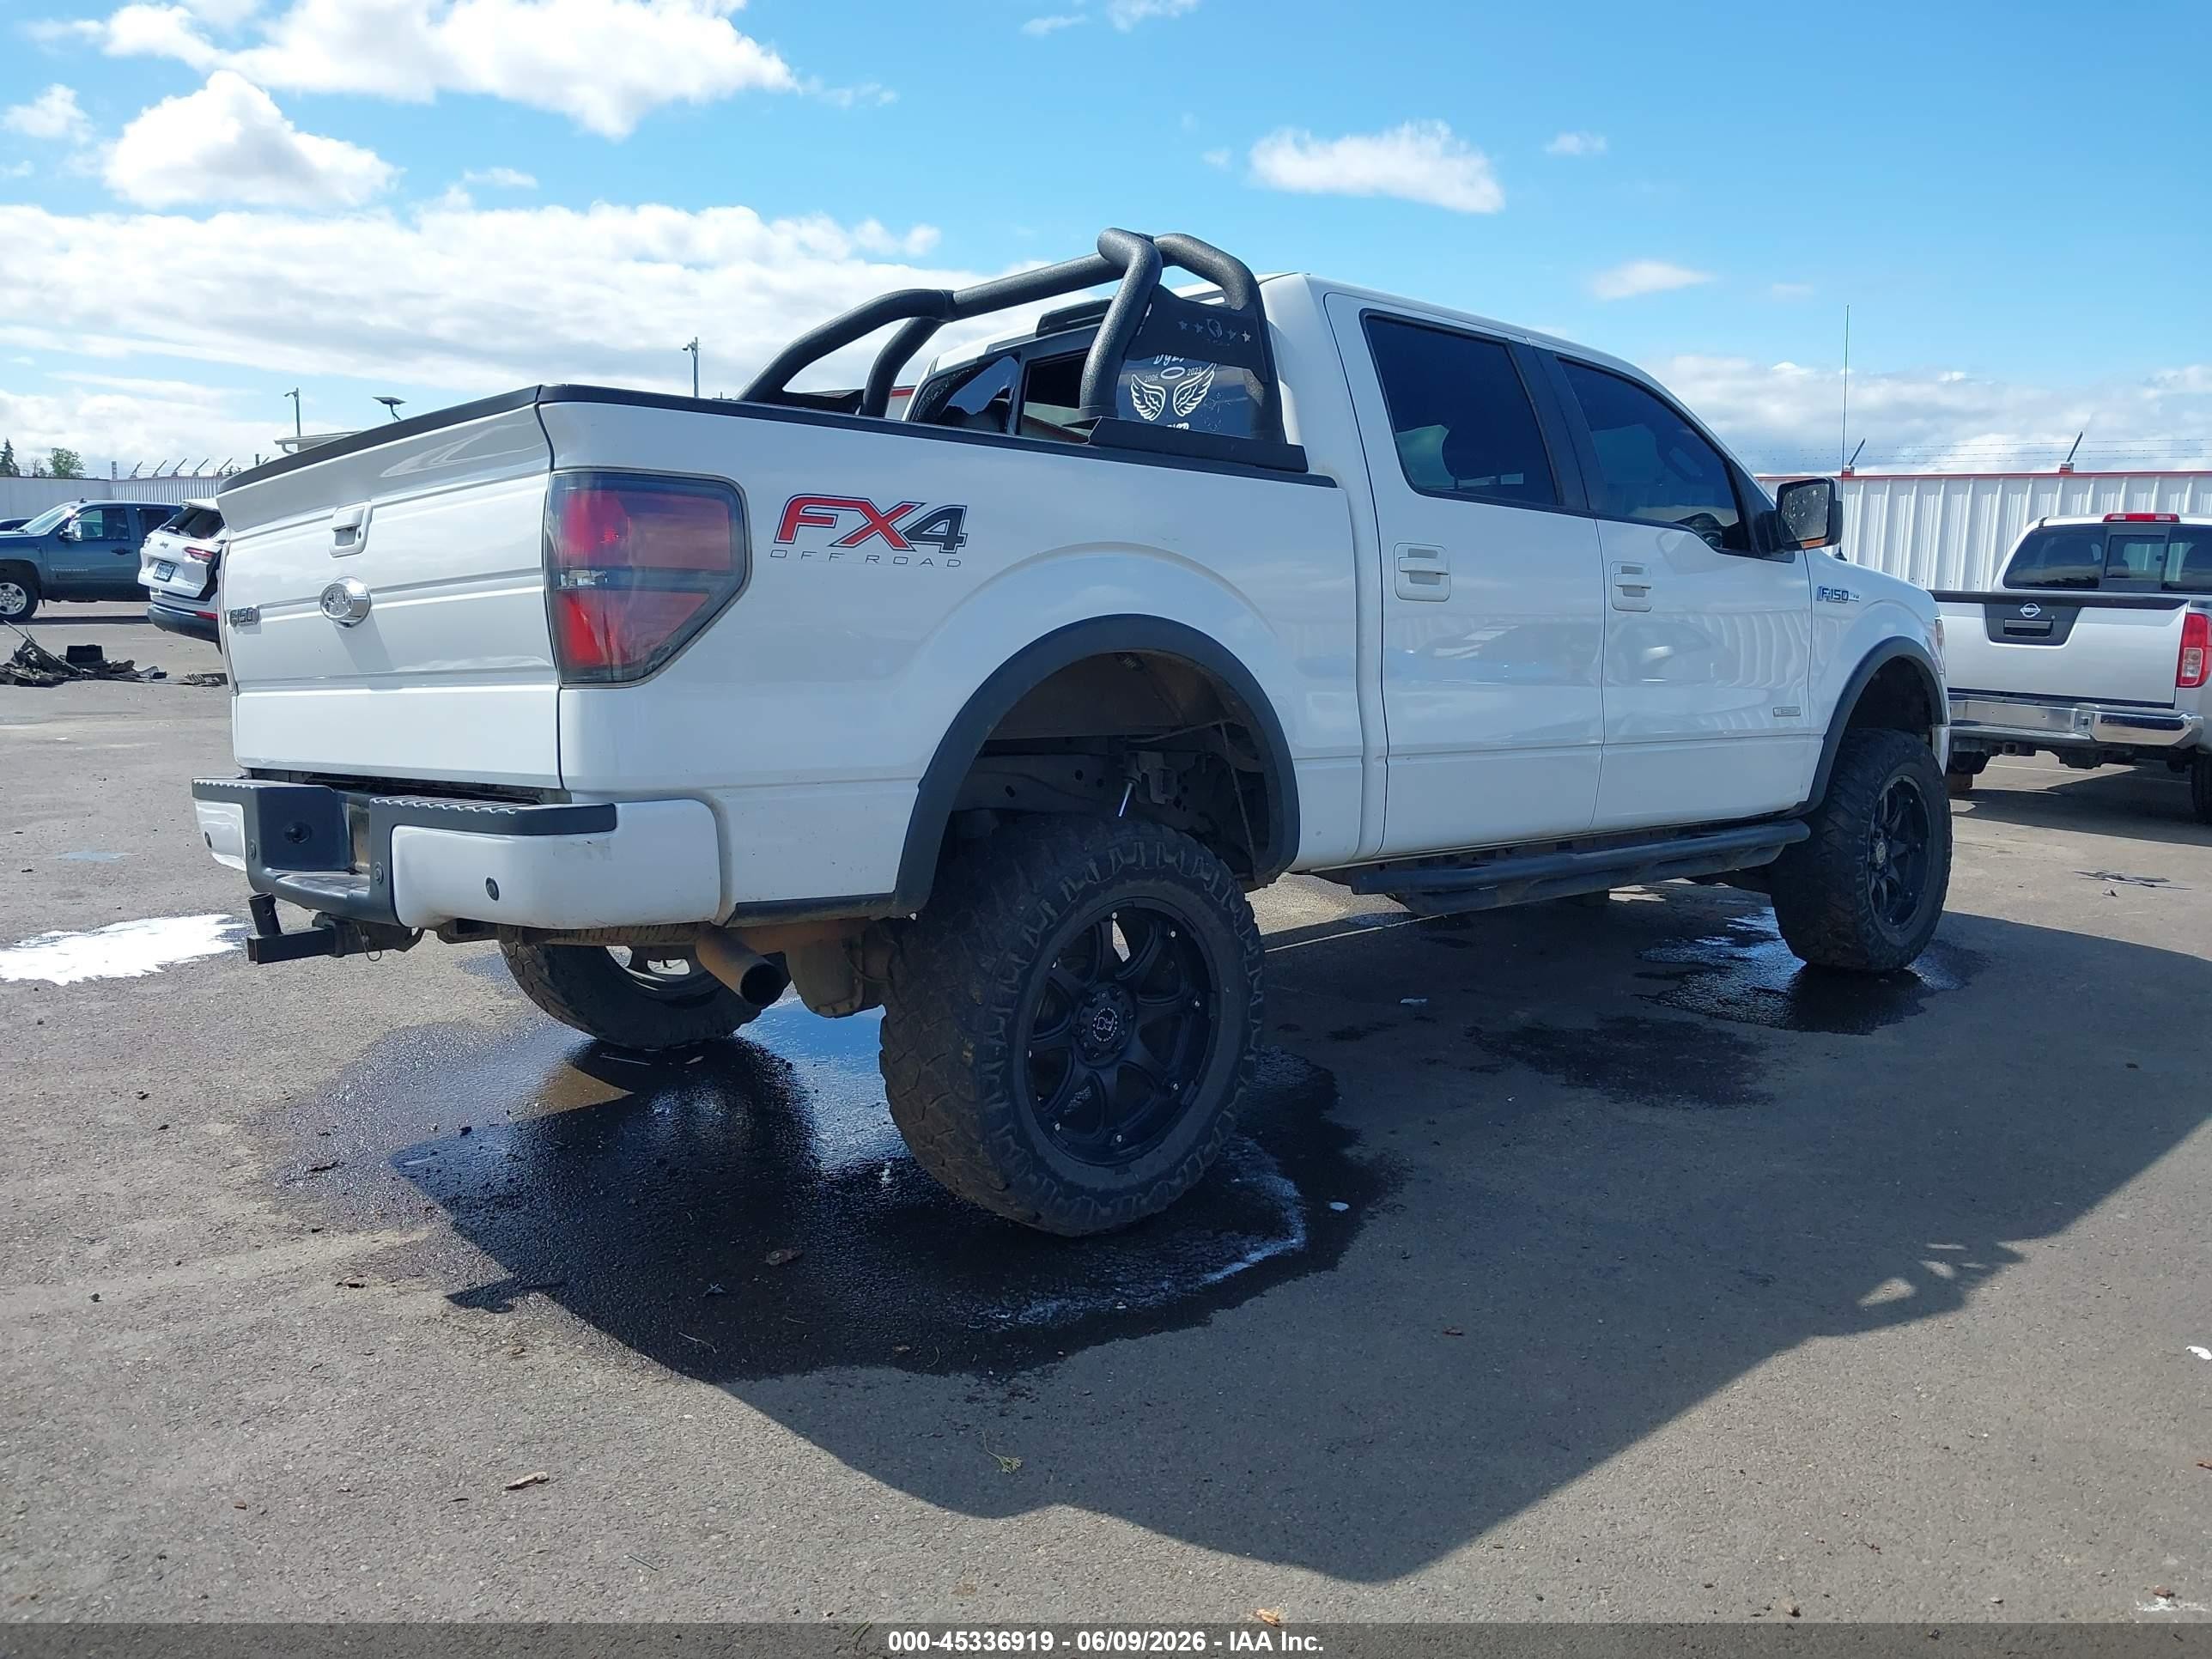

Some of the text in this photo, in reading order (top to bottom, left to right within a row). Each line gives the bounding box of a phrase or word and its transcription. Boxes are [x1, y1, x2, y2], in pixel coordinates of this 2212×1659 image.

[1187, 367, 1202, 376] 2023
[774, 493, 969, 554] FX4
[770, 550, 962, 568] OFF ROAD
